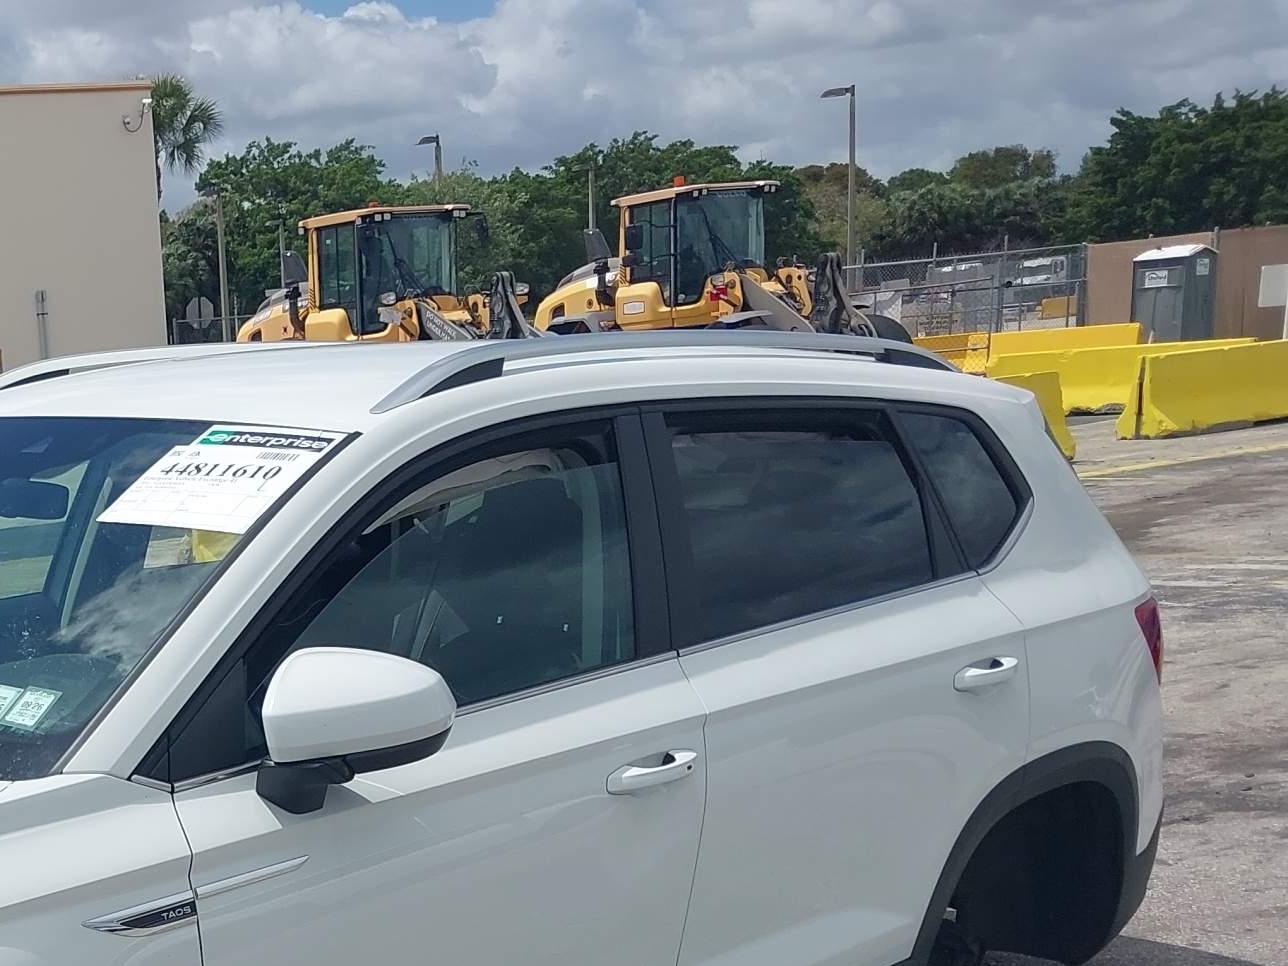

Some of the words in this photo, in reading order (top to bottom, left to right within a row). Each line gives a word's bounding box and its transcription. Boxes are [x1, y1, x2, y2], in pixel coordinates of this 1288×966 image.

[206, 431, 329, 449] enterprise
[161, 462, 282, 480] 44811610
[161, 905, 192, 921] TAOS
